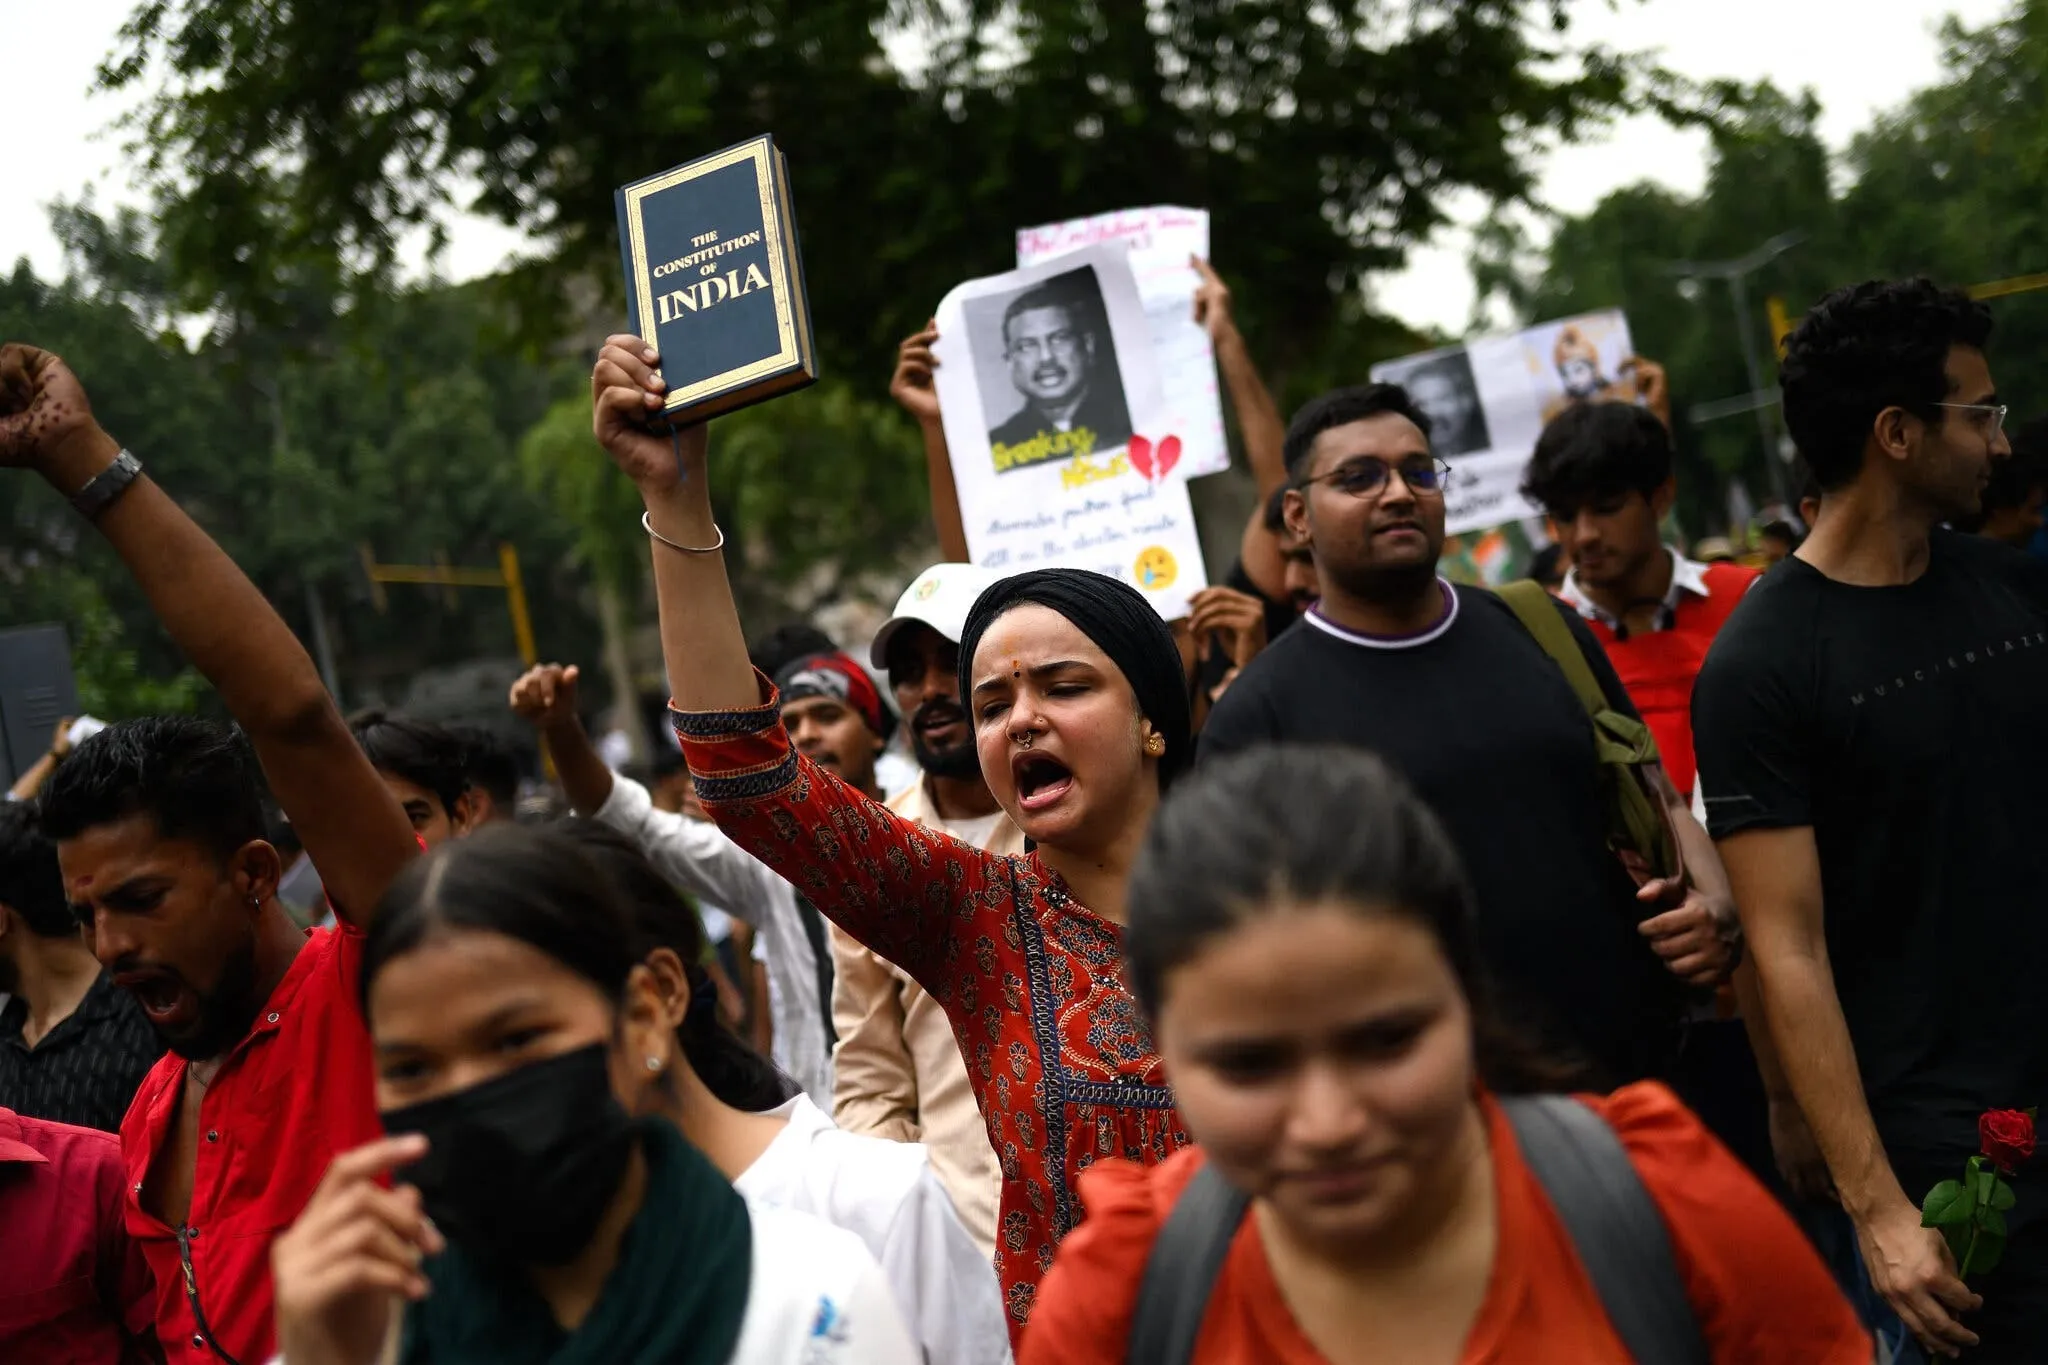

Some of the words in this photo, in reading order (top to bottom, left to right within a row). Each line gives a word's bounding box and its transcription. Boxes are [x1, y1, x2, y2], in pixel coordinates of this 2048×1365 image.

[654, 231, 760, 278] CONSTITUTION
[691, 230, 718, 248] THE
[700, 262, 717, 276] OF
[657, 263, 770, 324] INDIA
